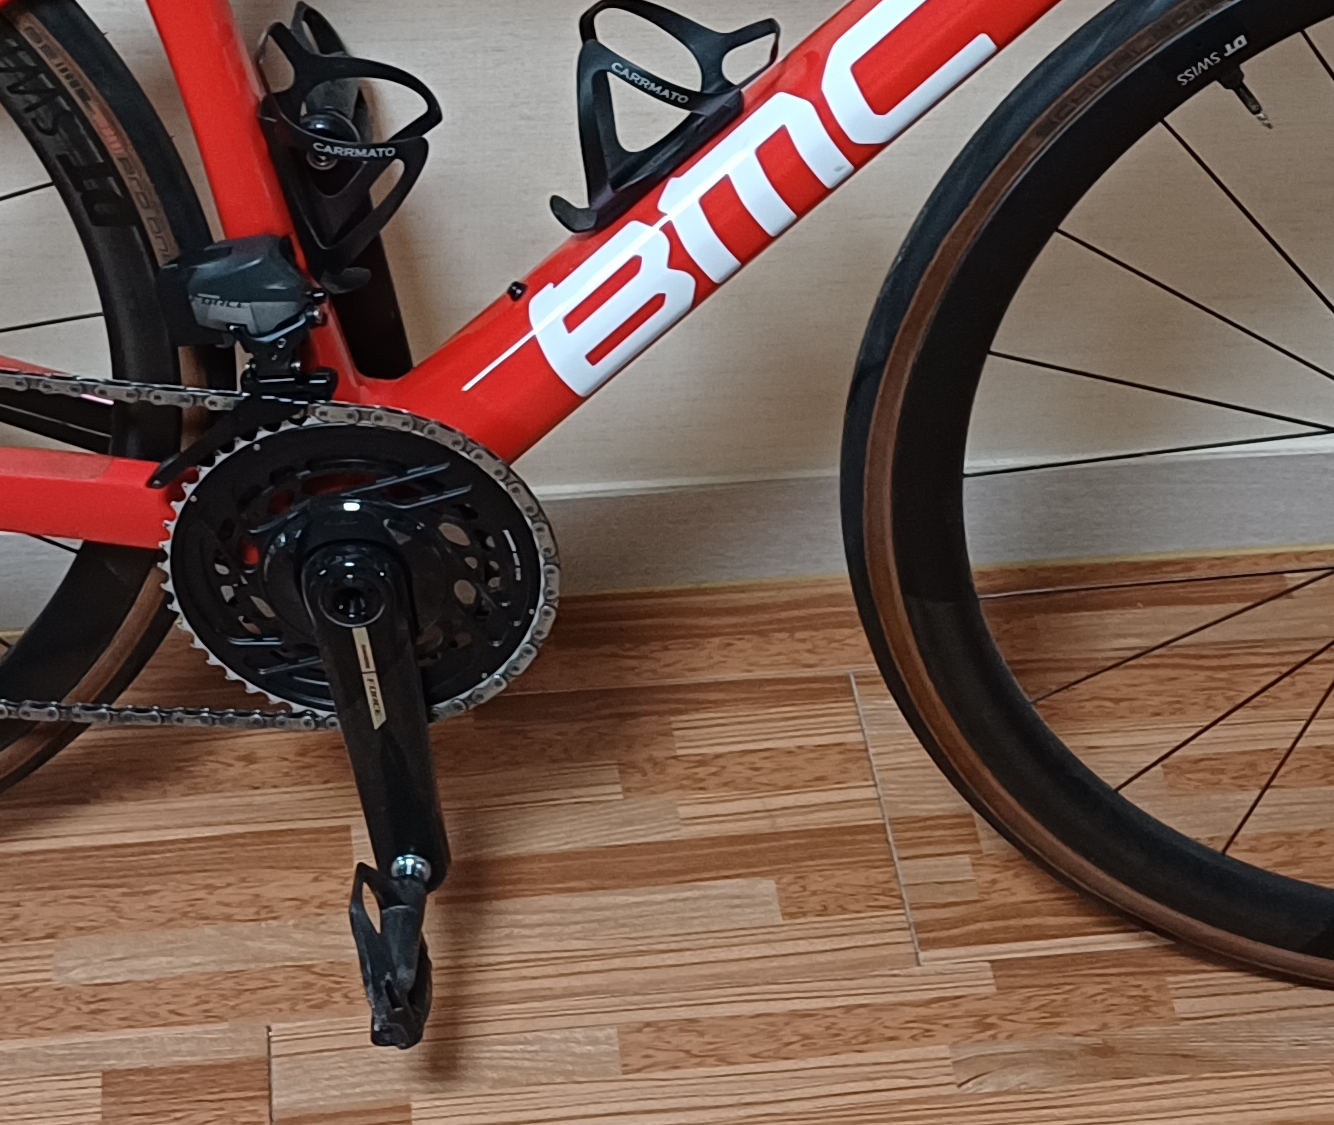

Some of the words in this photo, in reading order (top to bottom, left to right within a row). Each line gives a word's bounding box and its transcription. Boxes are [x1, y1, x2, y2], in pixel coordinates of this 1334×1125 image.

[1223, 34, 1248, 57] DT
[611, 61, 689, 104] CARRMATO
[1176, 51, 1222, 86] SWISS
[313, 141, 396, 158] CARRMATO
